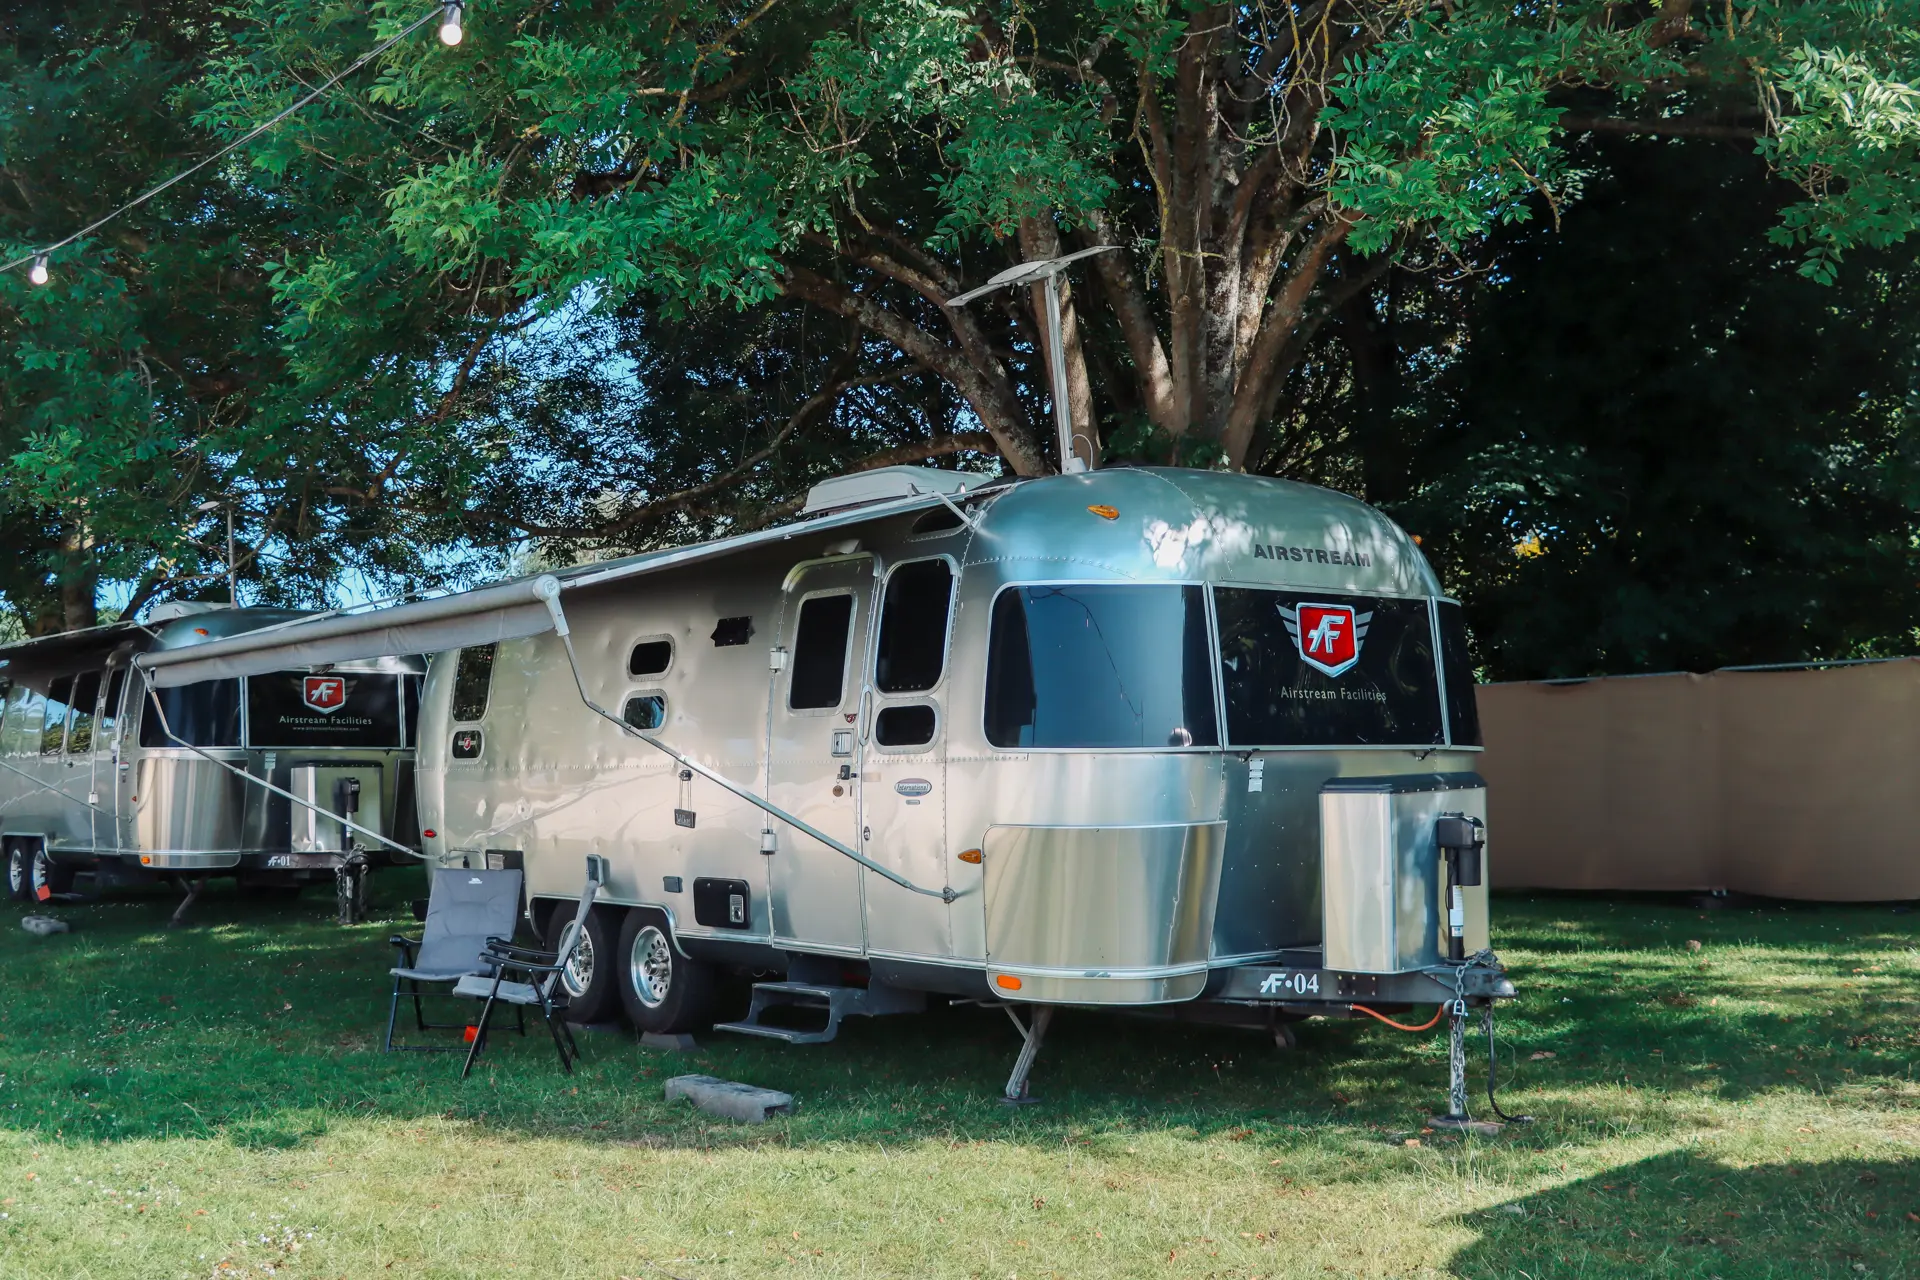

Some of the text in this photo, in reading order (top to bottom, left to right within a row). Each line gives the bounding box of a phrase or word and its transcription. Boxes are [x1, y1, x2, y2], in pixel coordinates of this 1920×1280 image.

[1254, 543, 1371, 568] AIRSTREAM
[1307, 614, 1346, 654] AF
[1280, 686, 1387, 701] Airstream Facilities
[278, 715, 373, 725] Airstream Facilities
